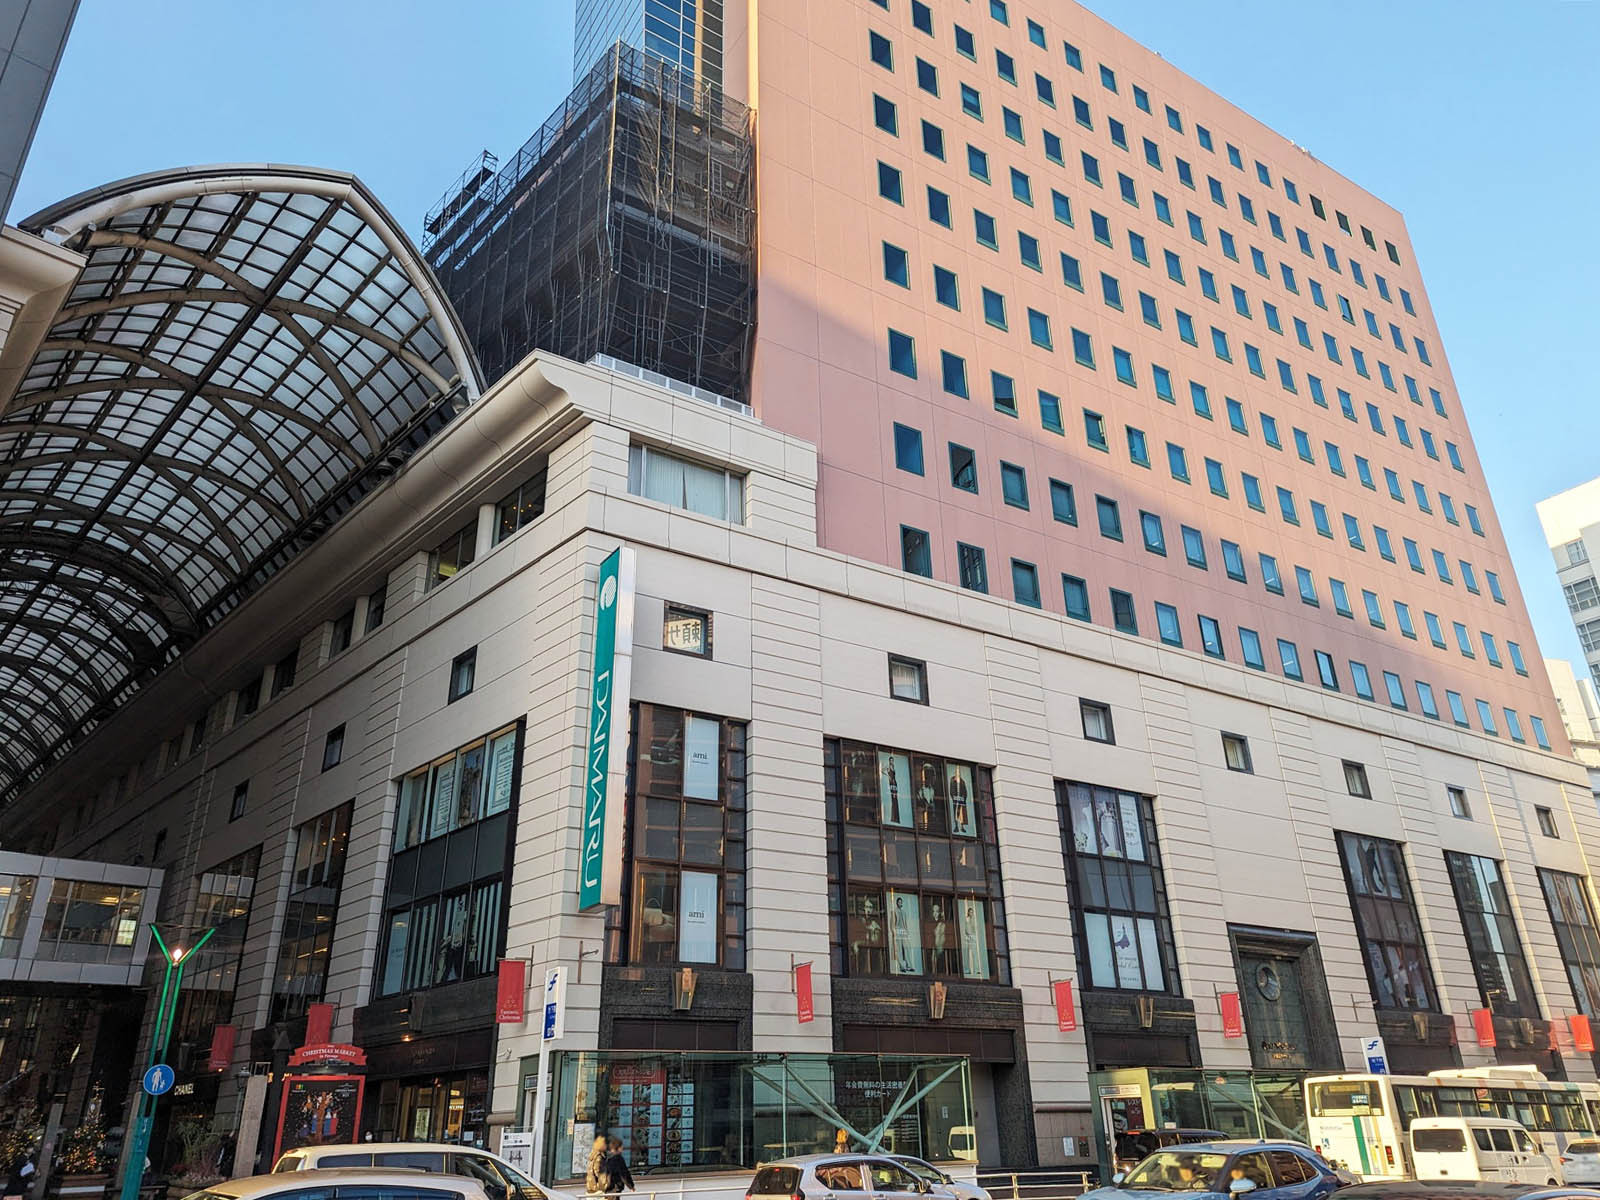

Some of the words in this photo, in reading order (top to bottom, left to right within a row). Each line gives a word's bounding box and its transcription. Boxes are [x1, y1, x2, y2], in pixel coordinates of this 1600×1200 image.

[692, 751, 708, 760] ami
[585, 670, 610, 888] DAIMARU
[688, 910, 705, 919] ami
[302, 1048, 334, 1057] CHRISTMAS
[334, 1049, 356, 1057] MARKET
[174, 1083, 194, 1096] CHANEL
